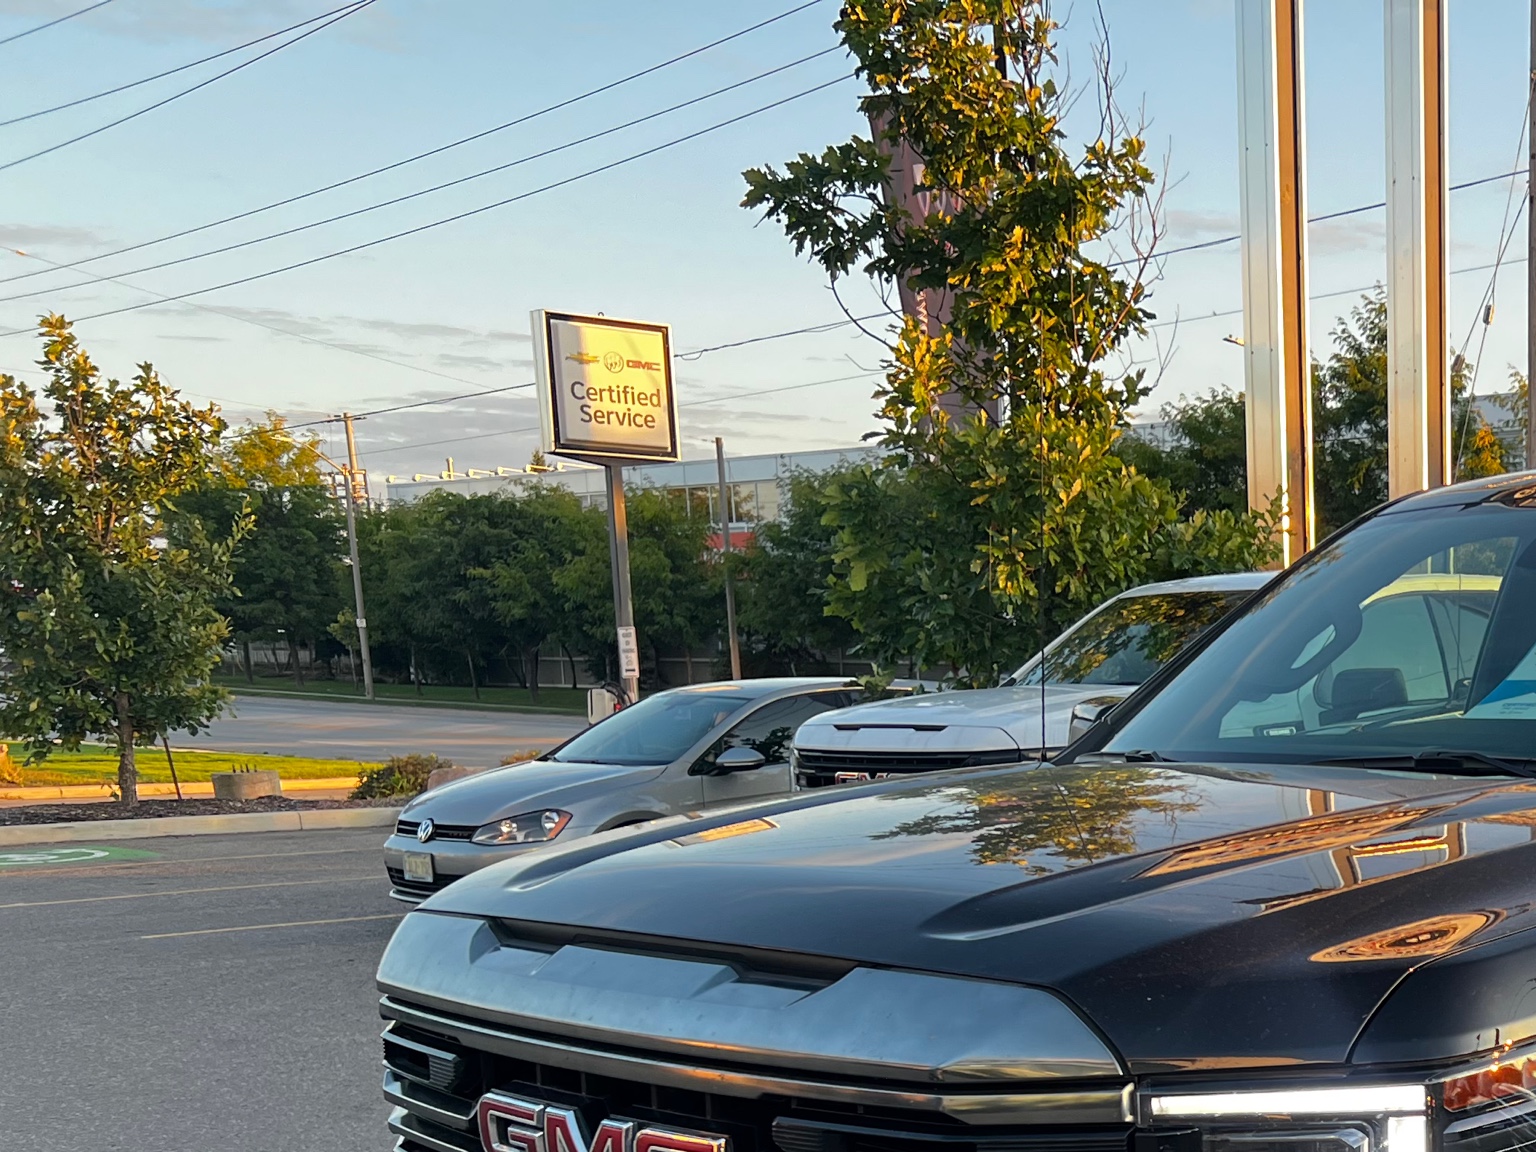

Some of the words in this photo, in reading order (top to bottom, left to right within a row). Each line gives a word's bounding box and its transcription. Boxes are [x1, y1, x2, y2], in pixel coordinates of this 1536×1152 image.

[625, 359, 661, 372] GMC
[570, 380, 662, 408] Certified
[579, 403, 656, 429] Service
